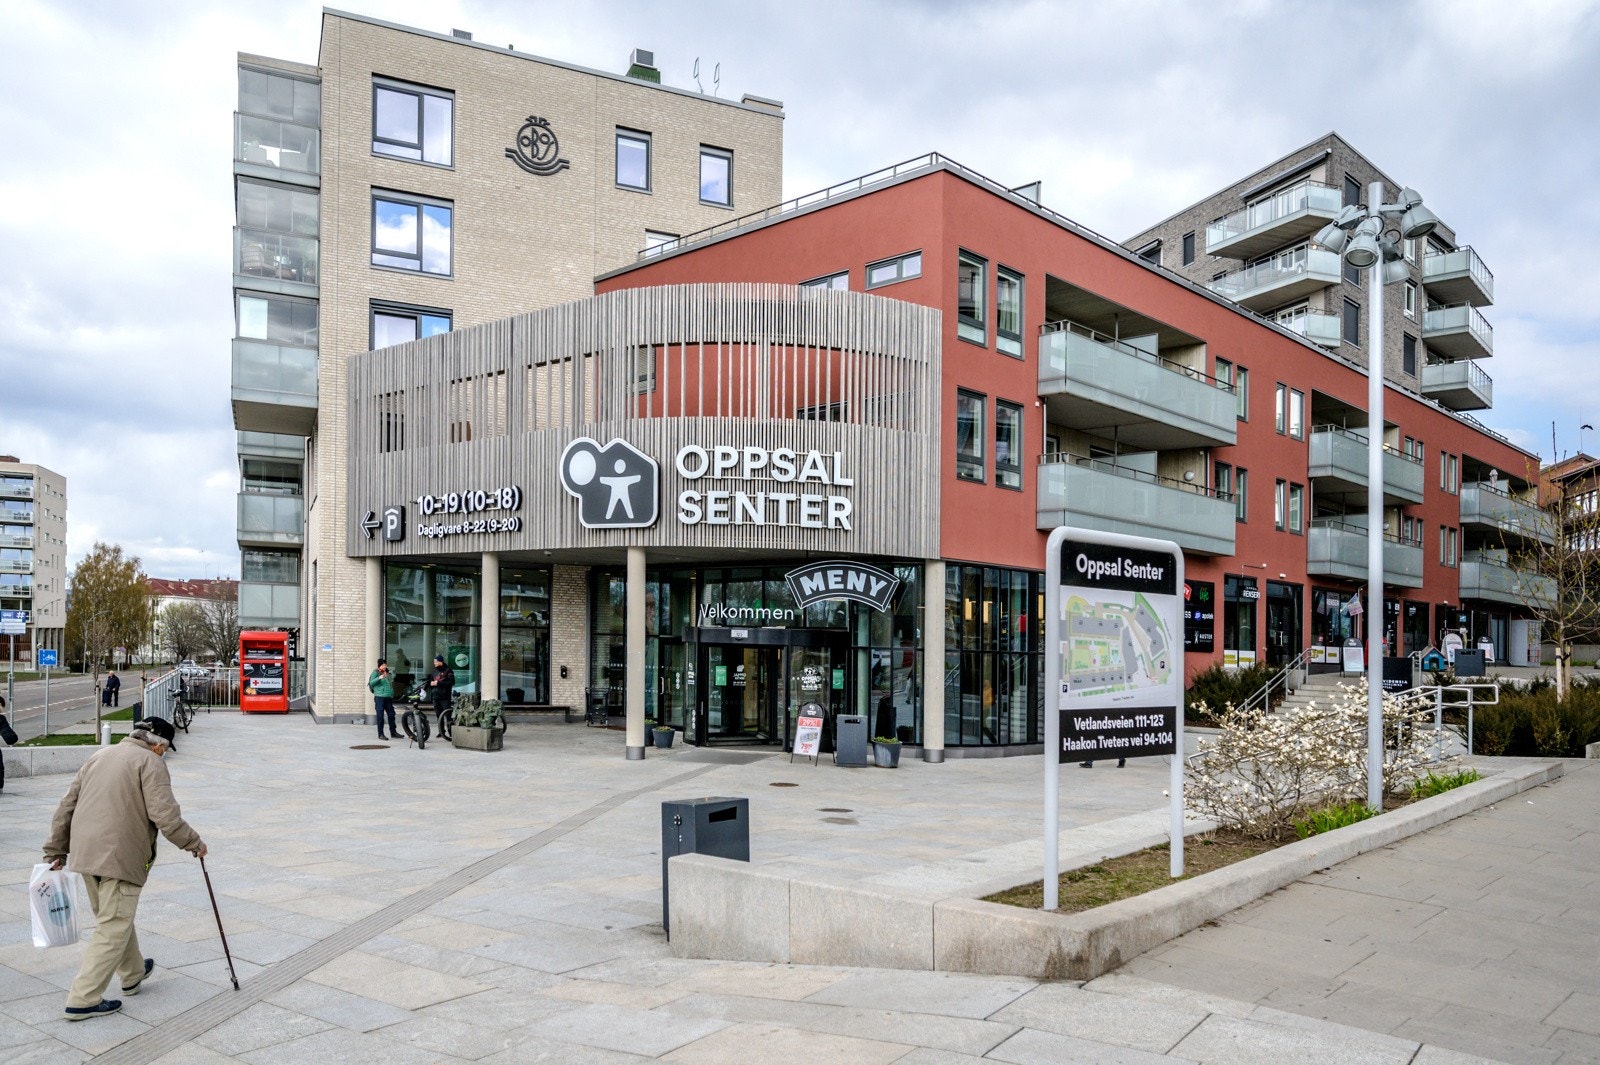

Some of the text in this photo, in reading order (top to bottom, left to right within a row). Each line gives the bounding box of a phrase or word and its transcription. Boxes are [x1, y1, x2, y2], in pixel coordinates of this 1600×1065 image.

[676, 445, 853, 486] OPPSAL
[417, 485, 520, 515] 10-19 (10-18)
[678, 490, 852, 530] SENTER
[418, 517, 519, 538] Dagligvare 8-22 (9-20)
[1076, 553, 1164, 580] Oppsal Senter
[800, 569, 887, 597] MENY
[700, 602, 794, 620] Velkommen
[1074, 714, 1164, 731] Vetlandsveien 111-123
[1063, 732, 1173, 751] Haakon Tveters vei 94-104
